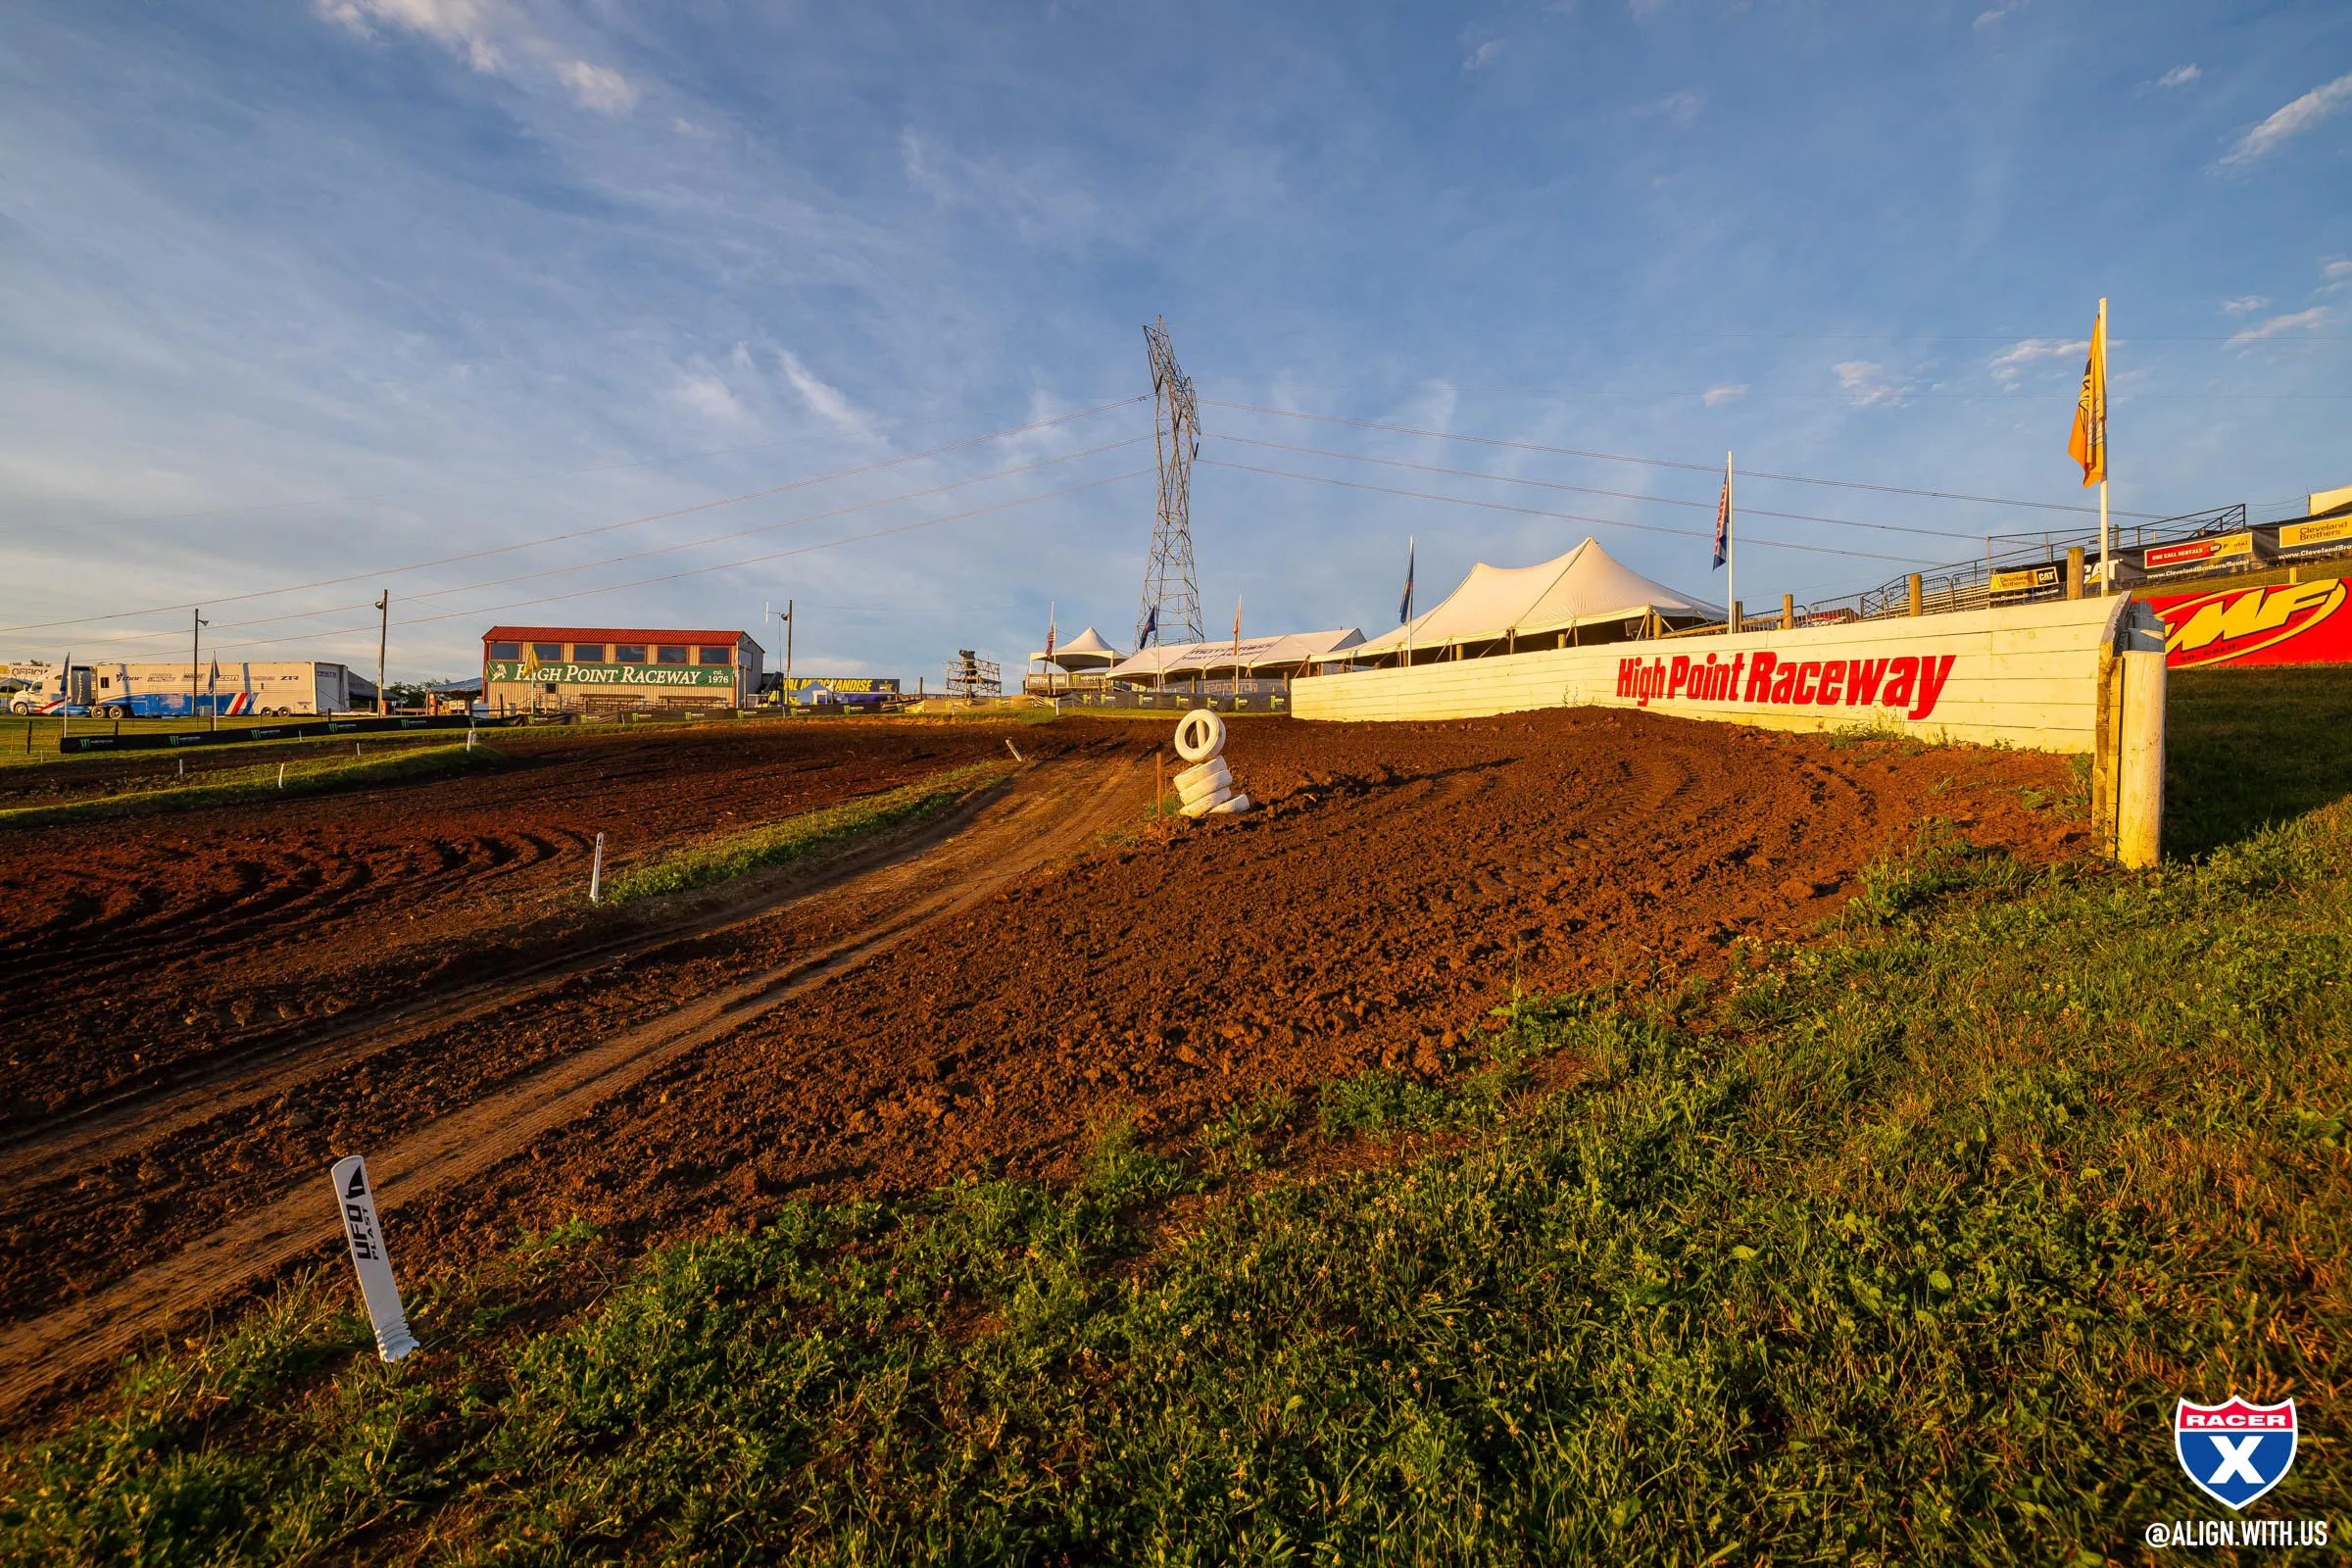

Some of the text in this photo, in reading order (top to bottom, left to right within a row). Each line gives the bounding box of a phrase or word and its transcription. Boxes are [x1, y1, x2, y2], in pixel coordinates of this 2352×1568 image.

[2299, 521, 2348, 534] Cleveland
[2299, 529, 2341, 541] Brothers
[2038, 571, 2055, 582] CAT
[2164, 578, 2341, 657] MF
[564, 665, 619, 682] POINT
[620, 666, 703, 685] RACEWAY
[708, 675, 729, 684] 1976
[1617, 652, 1956, 720] High Point Raceway
[346, 1203, 372, 1260] UFO
[361, 1206, 379, 1260] PLAST
